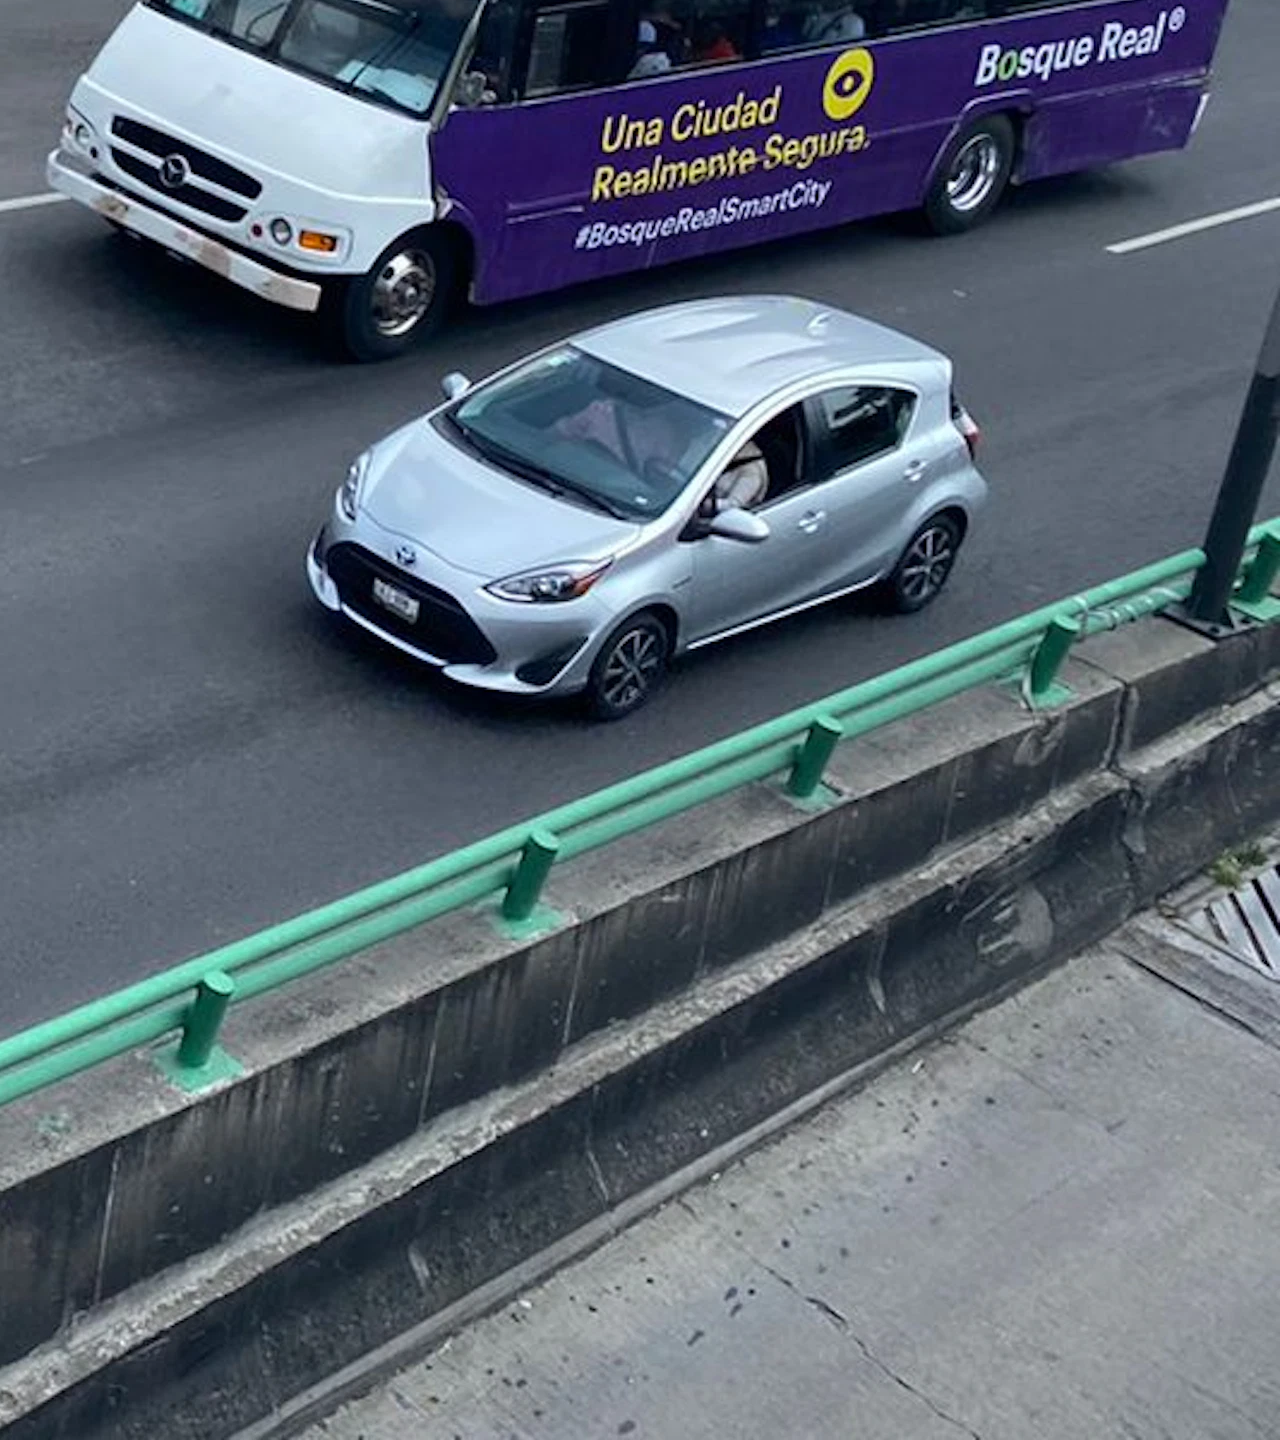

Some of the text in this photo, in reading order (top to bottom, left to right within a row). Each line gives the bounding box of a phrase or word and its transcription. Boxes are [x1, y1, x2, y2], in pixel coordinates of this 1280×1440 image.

[974, 36, 1095, 88] Bosque
[602, 85, 783, 154] Una Ciudad
[591, 124, 872, 202] Realmente Segura.
[574, 178, 833, 251] #BosqueRealSmartCity
